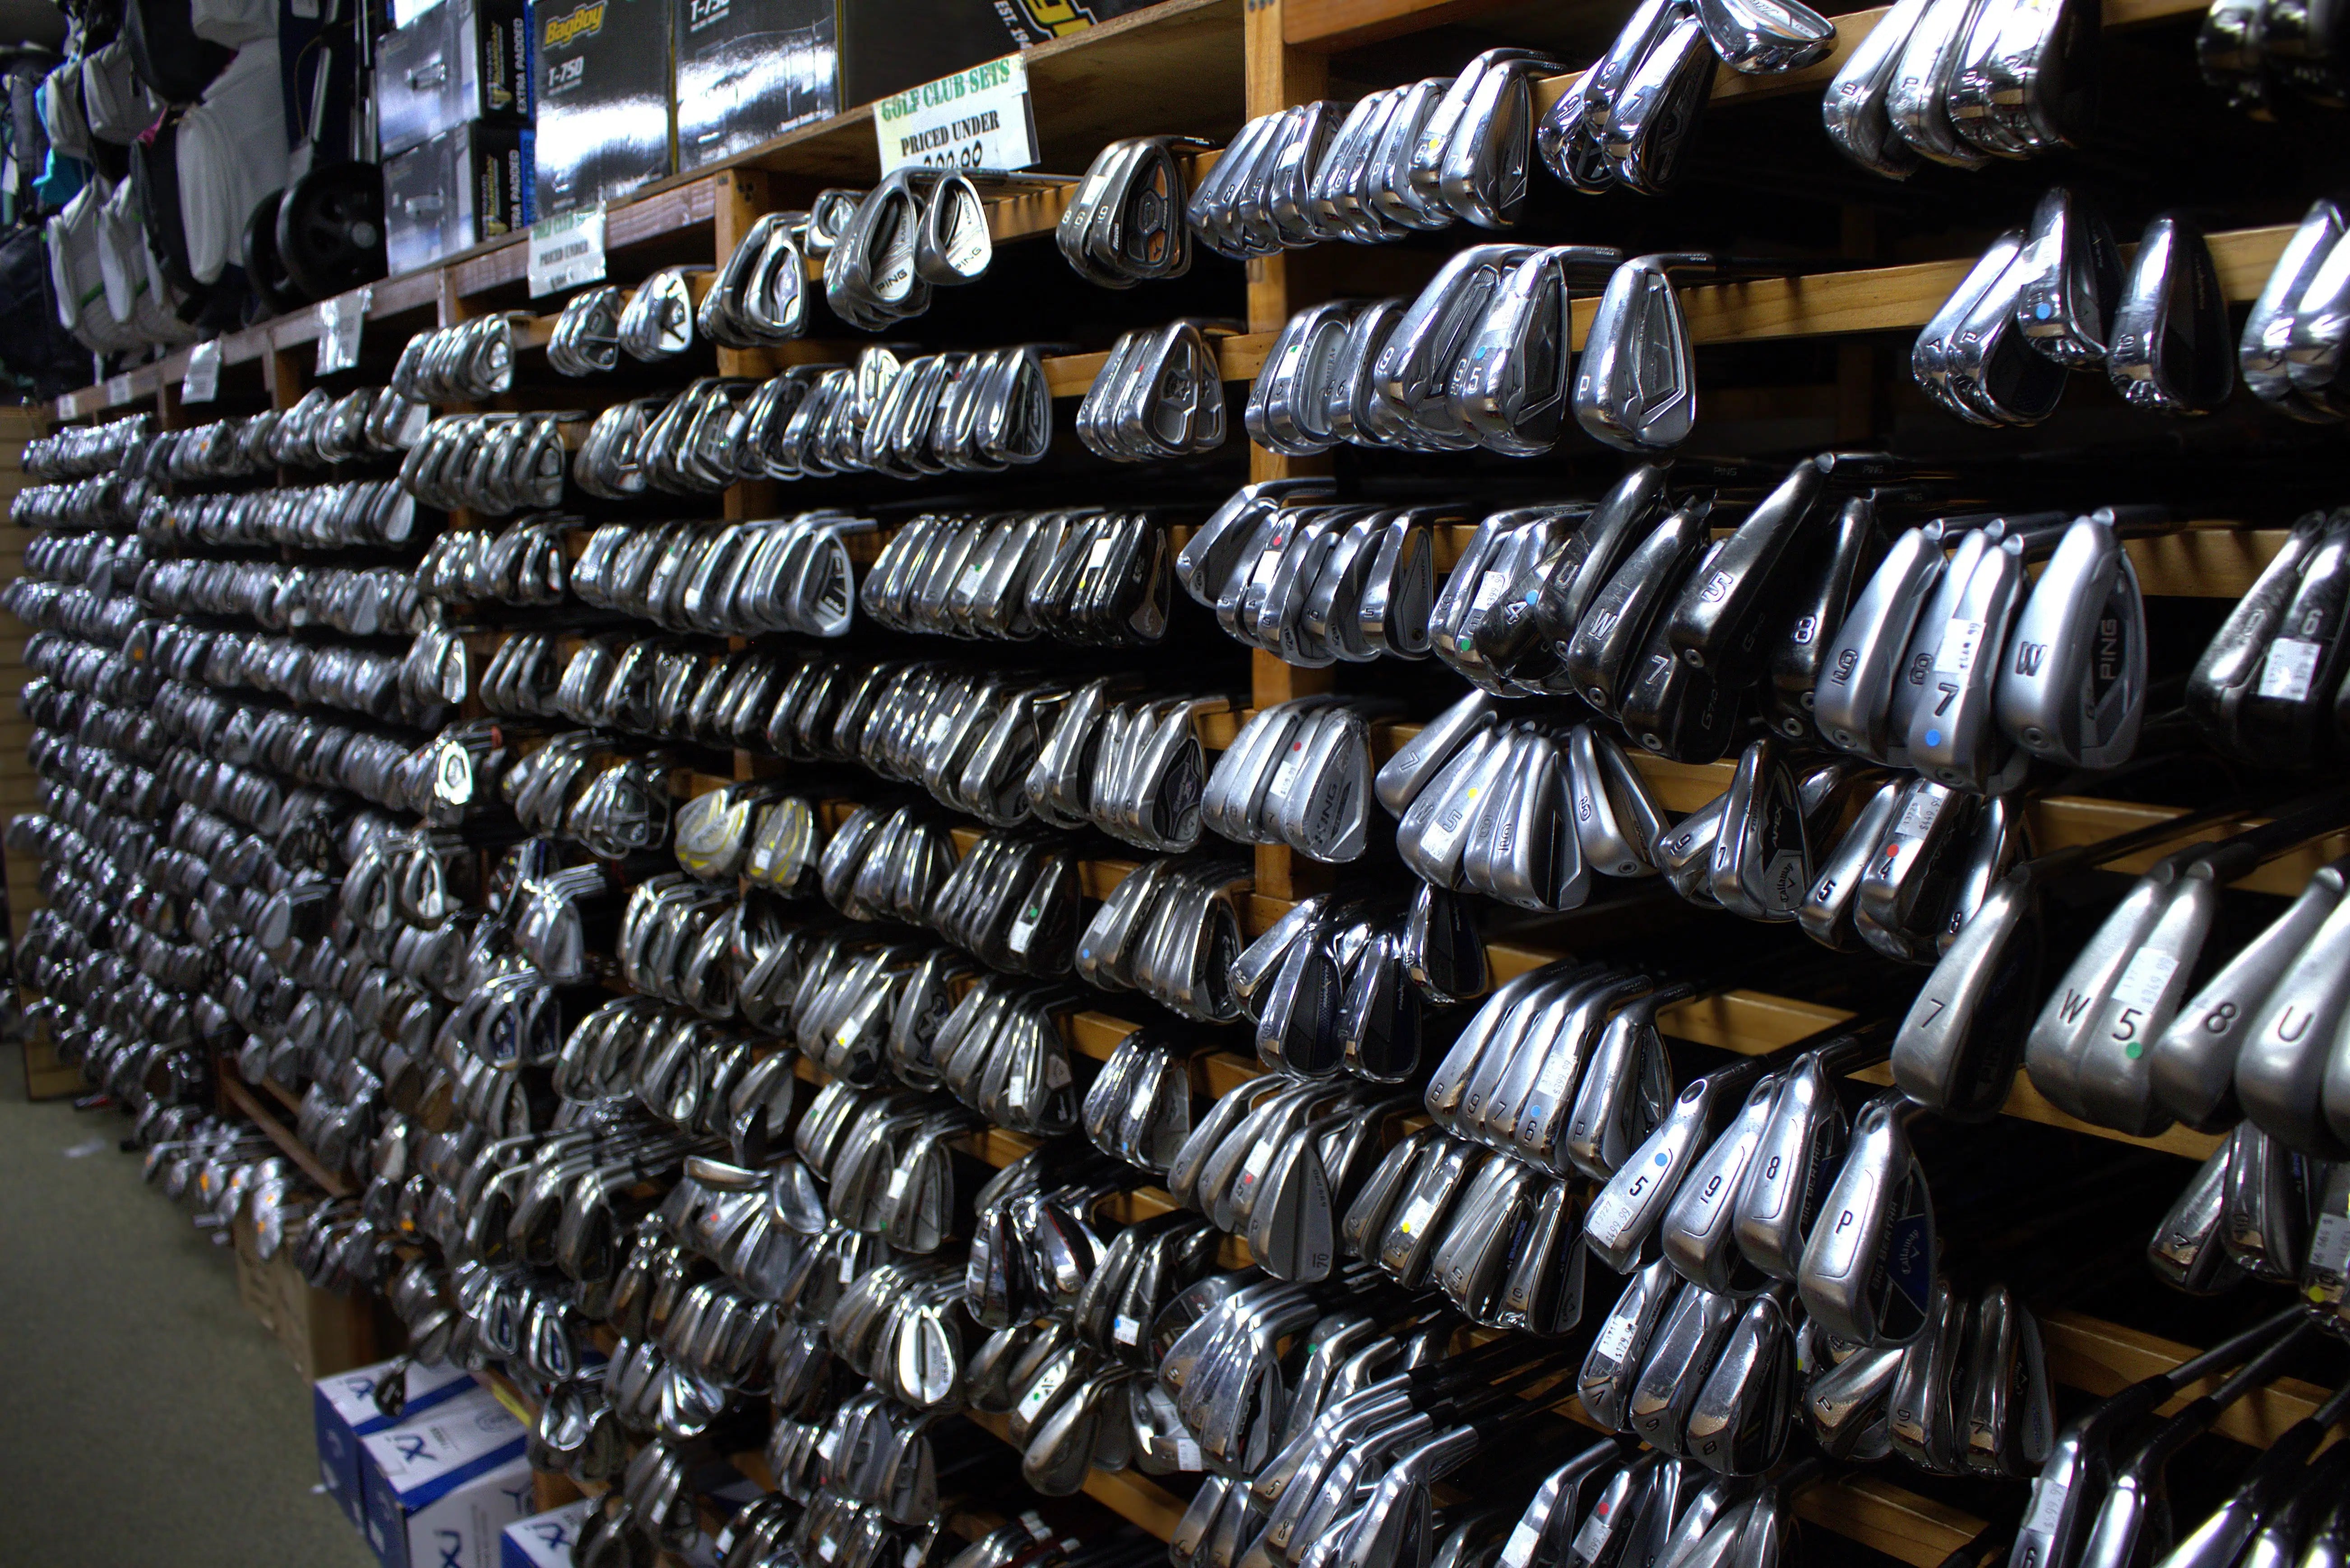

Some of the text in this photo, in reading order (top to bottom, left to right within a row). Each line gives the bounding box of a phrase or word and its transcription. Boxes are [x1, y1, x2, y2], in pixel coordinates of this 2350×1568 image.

[545, 4, 604, 44] BagBoy
[994, 1, 1018, 28] EST.
[513, 18, 527, 113] EXTRA PADDED
[881, 58, 1011, 122] GOLF CLUB SETS
[900, 110, 1000, 157] PRICED UNDER
[509, 149, 520, 202] PADDED
[1370, 162, 1381, 183] P
[1447, 155, 1459, 175] 7
[1334, 169, 1346, 189] 8
[1201, 191, 1212, 206] P
[1221, 184, 1235, 204] 8
[1062, 209, 1073, 225] 8
[954, 247, 982, 270] PING
[876, 269, 908, 293] PING
[1453, 359, 1467, 383] G
[1467, 366, 1482, 393] 5
[1336, 379, 1346, 397] 6
[1579, 375, 1590, 399] P
[1715, 467, 1737, 476] PING
[1701, 570, 1734, 604] 5
[1364, 608, 1374, 618] 5
[1505, 601, 1529, 625] 4
[1588, 607, 1618, 641] W
[1792, 615, 1817, 645] 8
[2015, 641, 2048, 677] W
[2100, 618, 2118, 680] PING
[1646, 654, 1670, 685] 7
[1909, 653, 1933, 686] 8
[1934, 683, 1959, 718] 7
[1399, 752, 1420, 772] 7
[1315, 782, 1339, 846] KING
[1412, 798, 1433, 824] W
[1442, 809, 1462, 833] 5
[1579, 796, 1592, 822] 6
[1771, 804, 1783, 847] APEX
[1716, 845, 1727, 869] 7
[1879, 857, 1895, 880] 4
[1778, 862, 1795, 903] Callaway
[1817, 879, 1836, 902] 5
[1949, 911, 1962, 935] 8
[1920, 998, 1946, 1029] 7
[2059, 987, 2090, 1024] W
[2202, 1002, 2237, 1034] 8
[2111, 1009, 2142, 1042] 5
[2277, 1005, 2314, 1043] U
[1431, 1082, 1444, 1102] 8
[1492, 1101, 1507, 1121] 7
[1571, 1121, 1585, 1143] P
[1766, 1156, 1781, 1181] 8
[1629, 1177, 1648, 1197] 5
[1704, 1175, 1721, 1201] 9
[1595, 1200, 1613, 1227] 13727
[1605, 1207, 1632, 1245] $499.99
[1835, 1209, 1852, 1235] P
[1872, 1201, 1899, 1291] BIG BERTHA
[1901, 1230, 1920, 1276] Callaway
[1316, 1253, 1330, 1269] 70
[1591, 1390, 1605, 1406] 7
[1969, 1420, 1985, 1435] 7
[1703, 1443, 1718, 1456] 8
[1265, 1480, 1281, 1496] 5
[1277, 1519, 1290, 1541] 8
